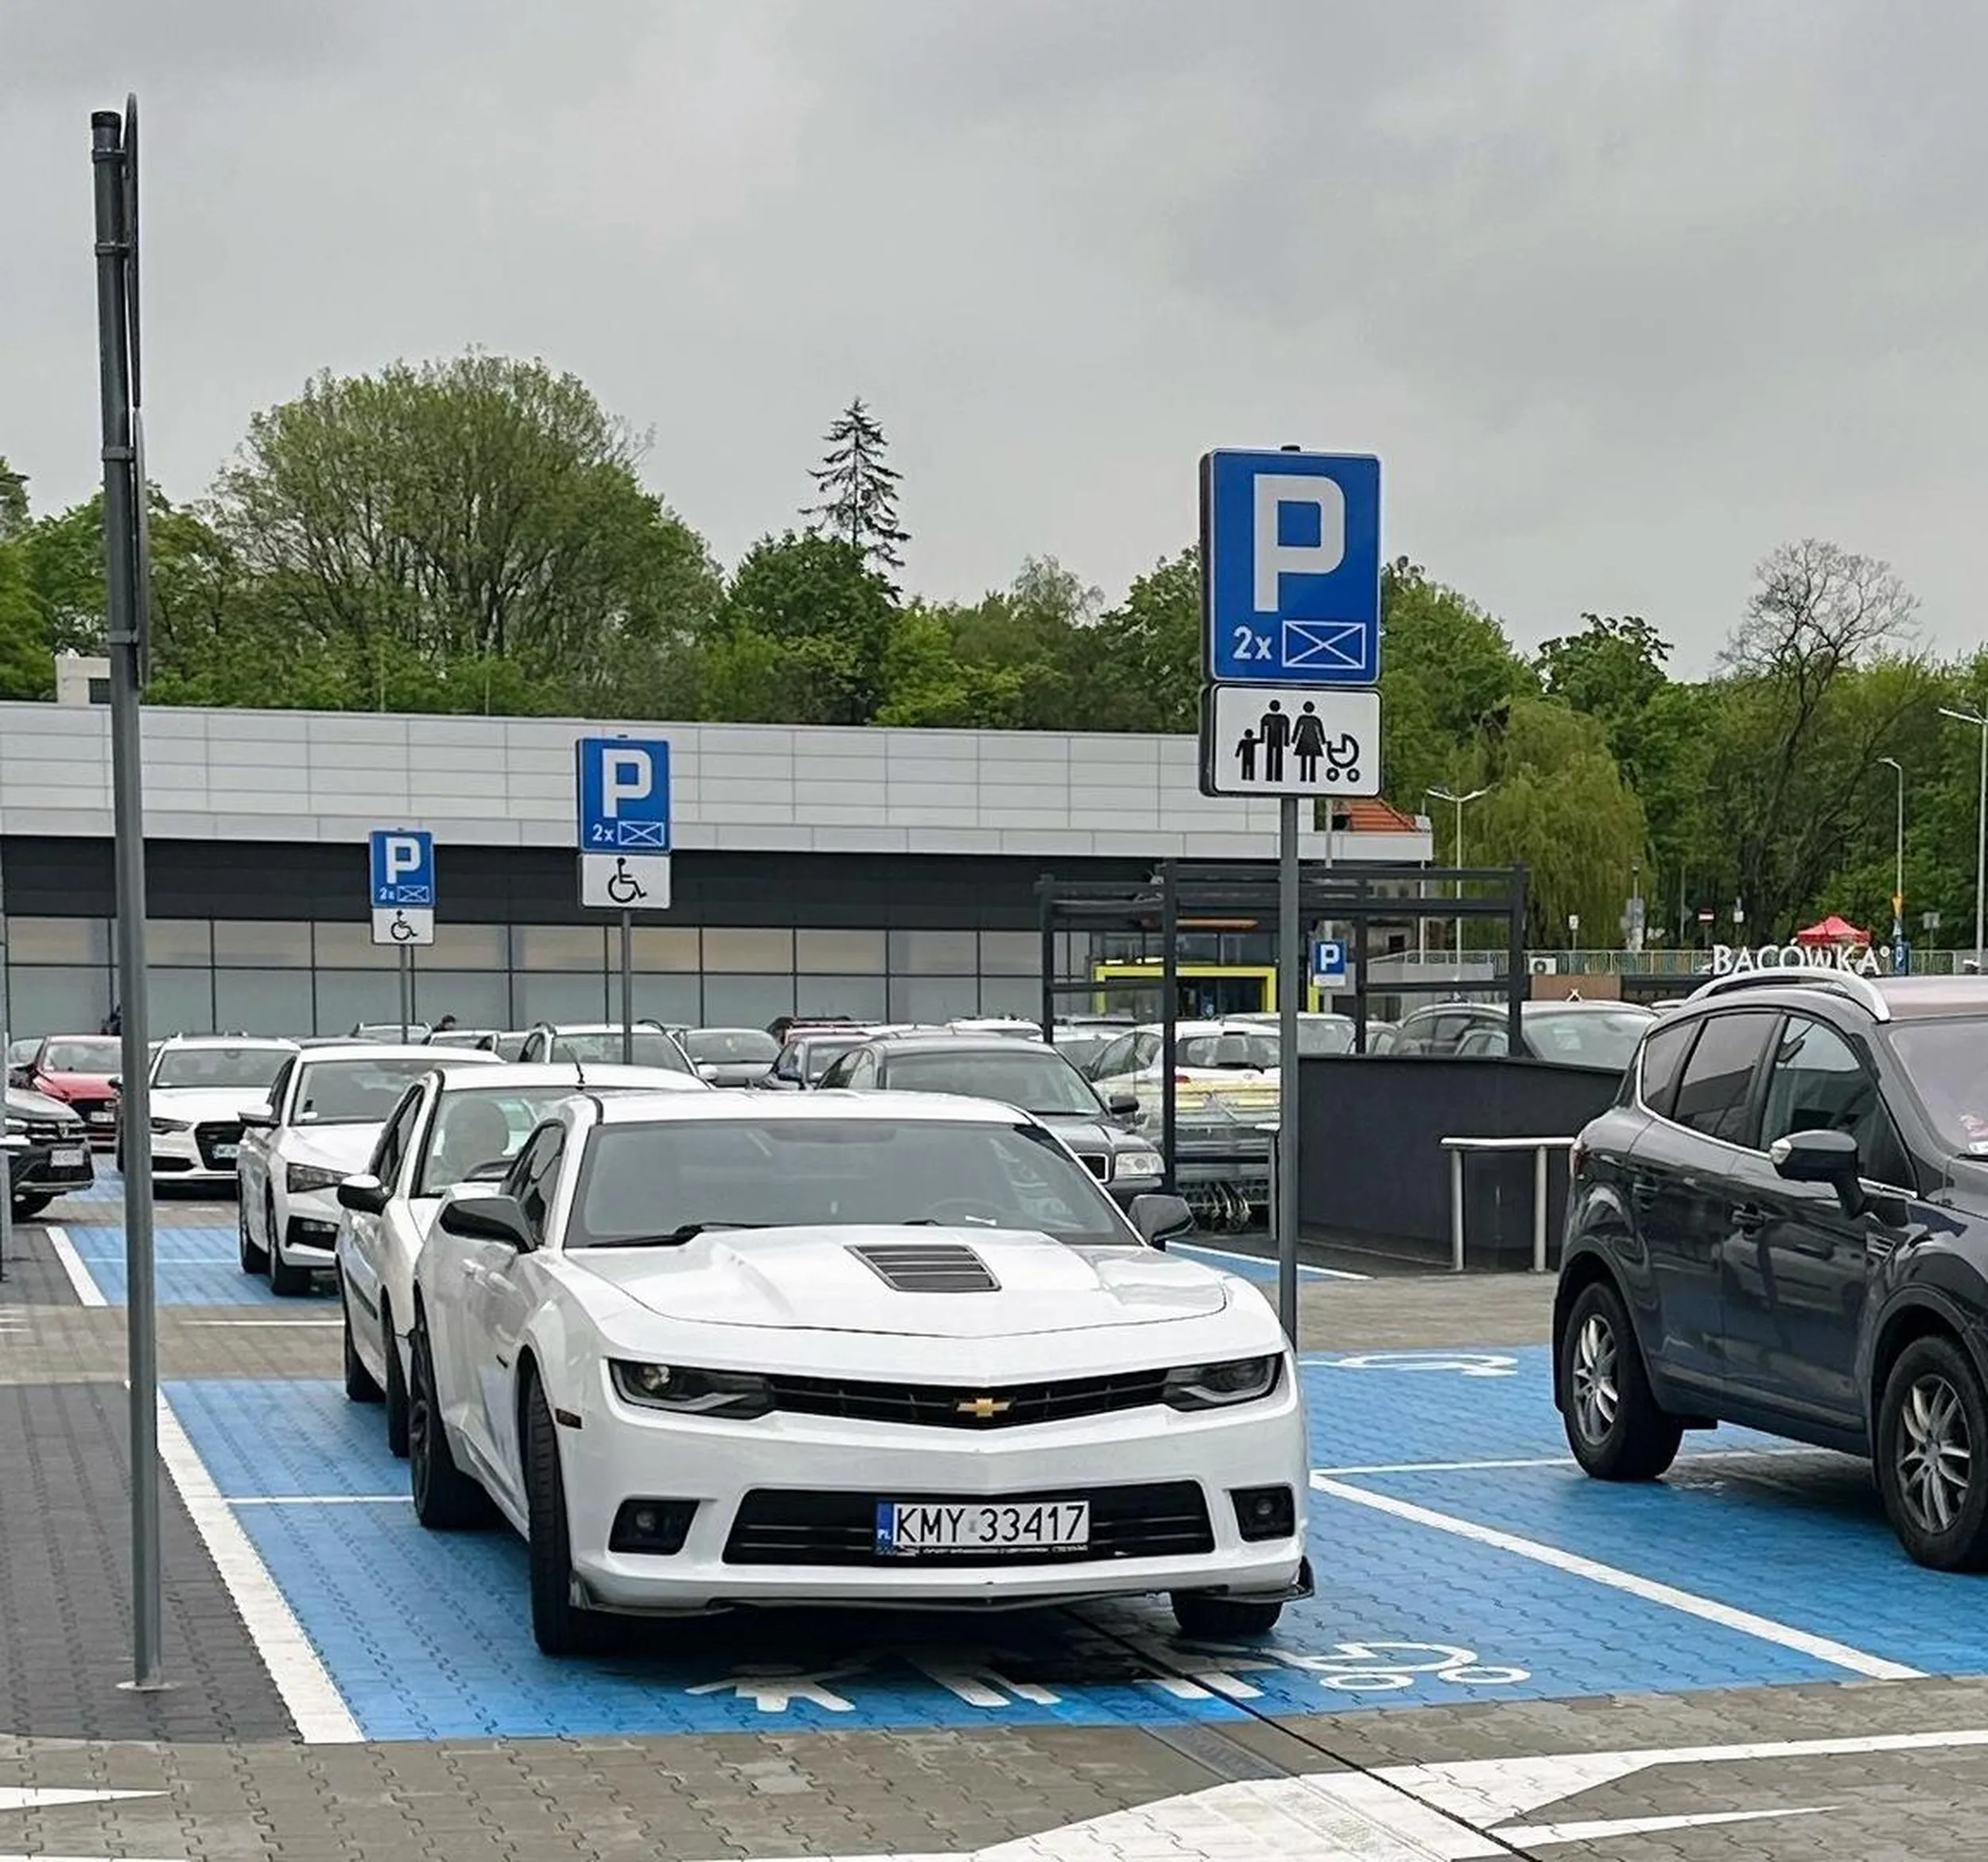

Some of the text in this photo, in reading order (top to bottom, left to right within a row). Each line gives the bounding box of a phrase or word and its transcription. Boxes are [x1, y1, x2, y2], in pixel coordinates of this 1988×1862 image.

[1253, 474, 1345, 612] P
[1233, 626, 1272, 661] 2x
[602, 748, 652, 818] P
[592, 824, 615, 842] 2x
[386, 837, 421, 884] P
[1320, 944, 1340, 971] P
[896, 1504, 1085, 1543] KMY 33417
